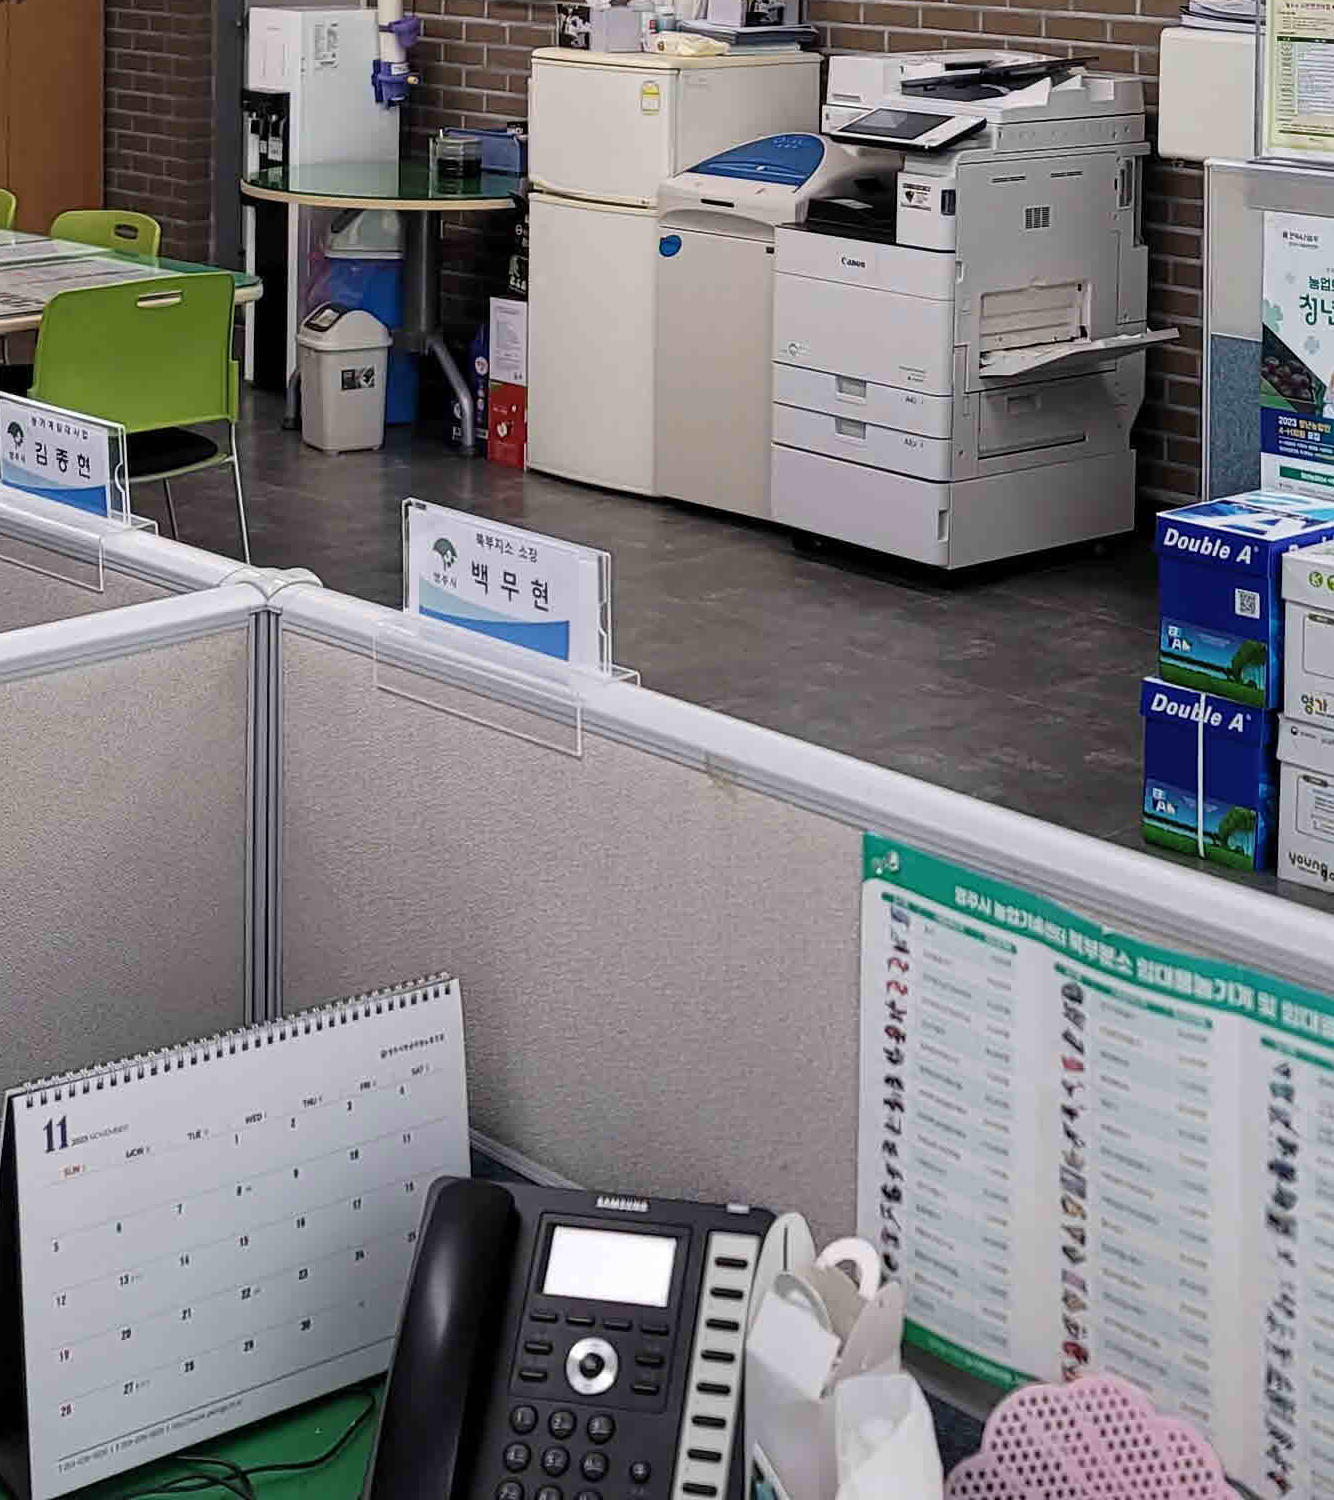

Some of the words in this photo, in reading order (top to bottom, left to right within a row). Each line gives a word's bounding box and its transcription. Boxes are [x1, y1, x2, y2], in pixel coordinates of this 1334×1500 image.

[841, 256, 866, 268] Canon
[1278, 416, 1298, 428] 2023
[476, 532, 515, 555] 북부지소
[518, 545, 538, 563] 소장
[1163, 527, 1231, 560] Double
[1235, 544, 1252, 565] A
[1150, 693, 1223, 727] Double
[1227, 713, 1244, 733] A
[43, 1115, 69, 1154] 11
[594, 1195, 650, 1213] SAMSUNG
